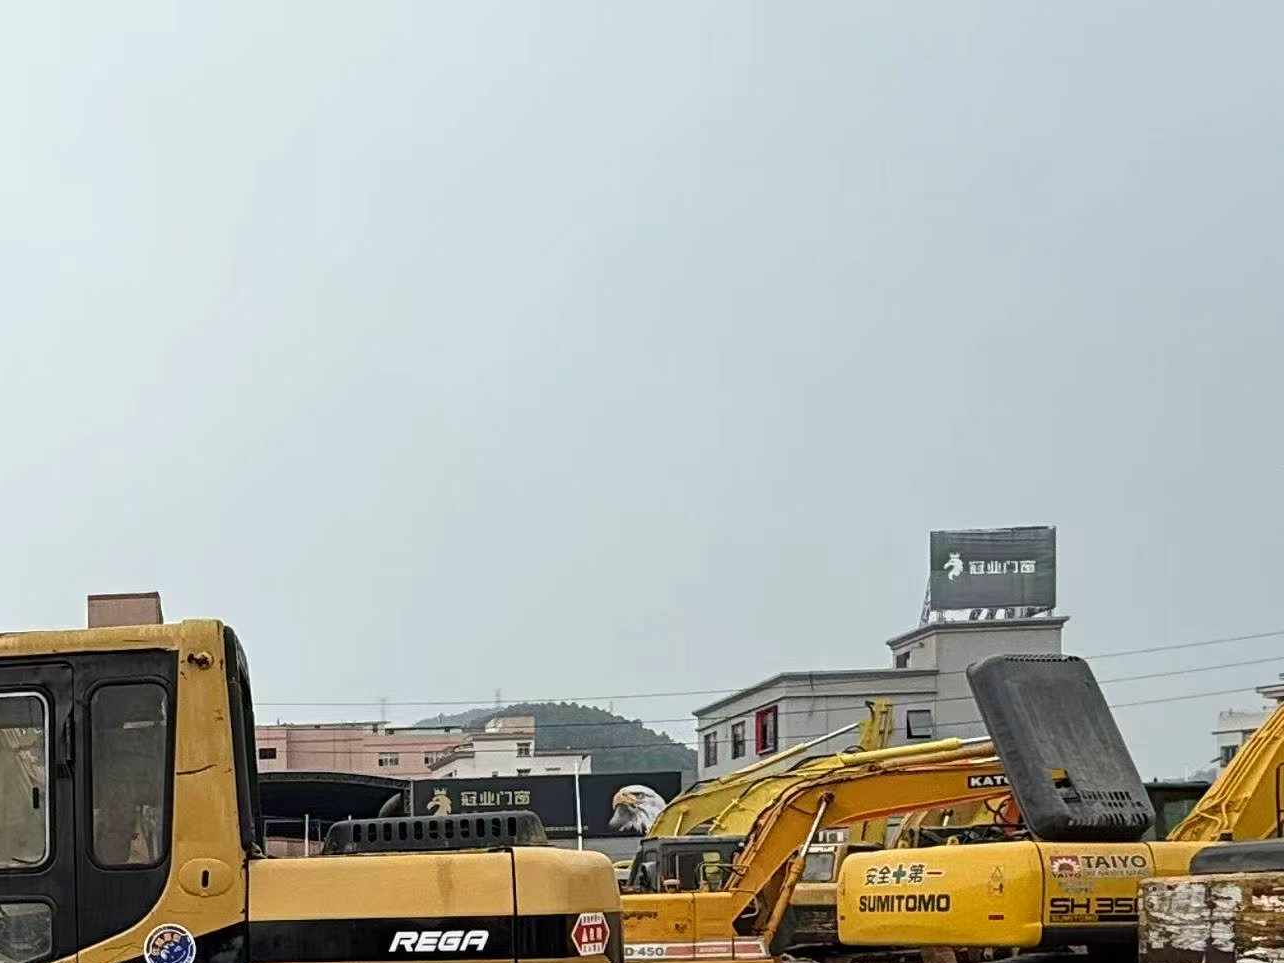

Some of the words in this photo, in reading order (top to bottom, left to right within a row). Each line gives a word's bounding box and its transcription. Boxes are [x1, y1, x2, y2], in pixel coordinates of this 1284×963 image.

[1081, 855, 1147, 869] TAIYO
[859, 894, 951, 913] SUMITOMO
[388, 930, 490, 953] REGA
[624, 947, 664, 957] D-450
